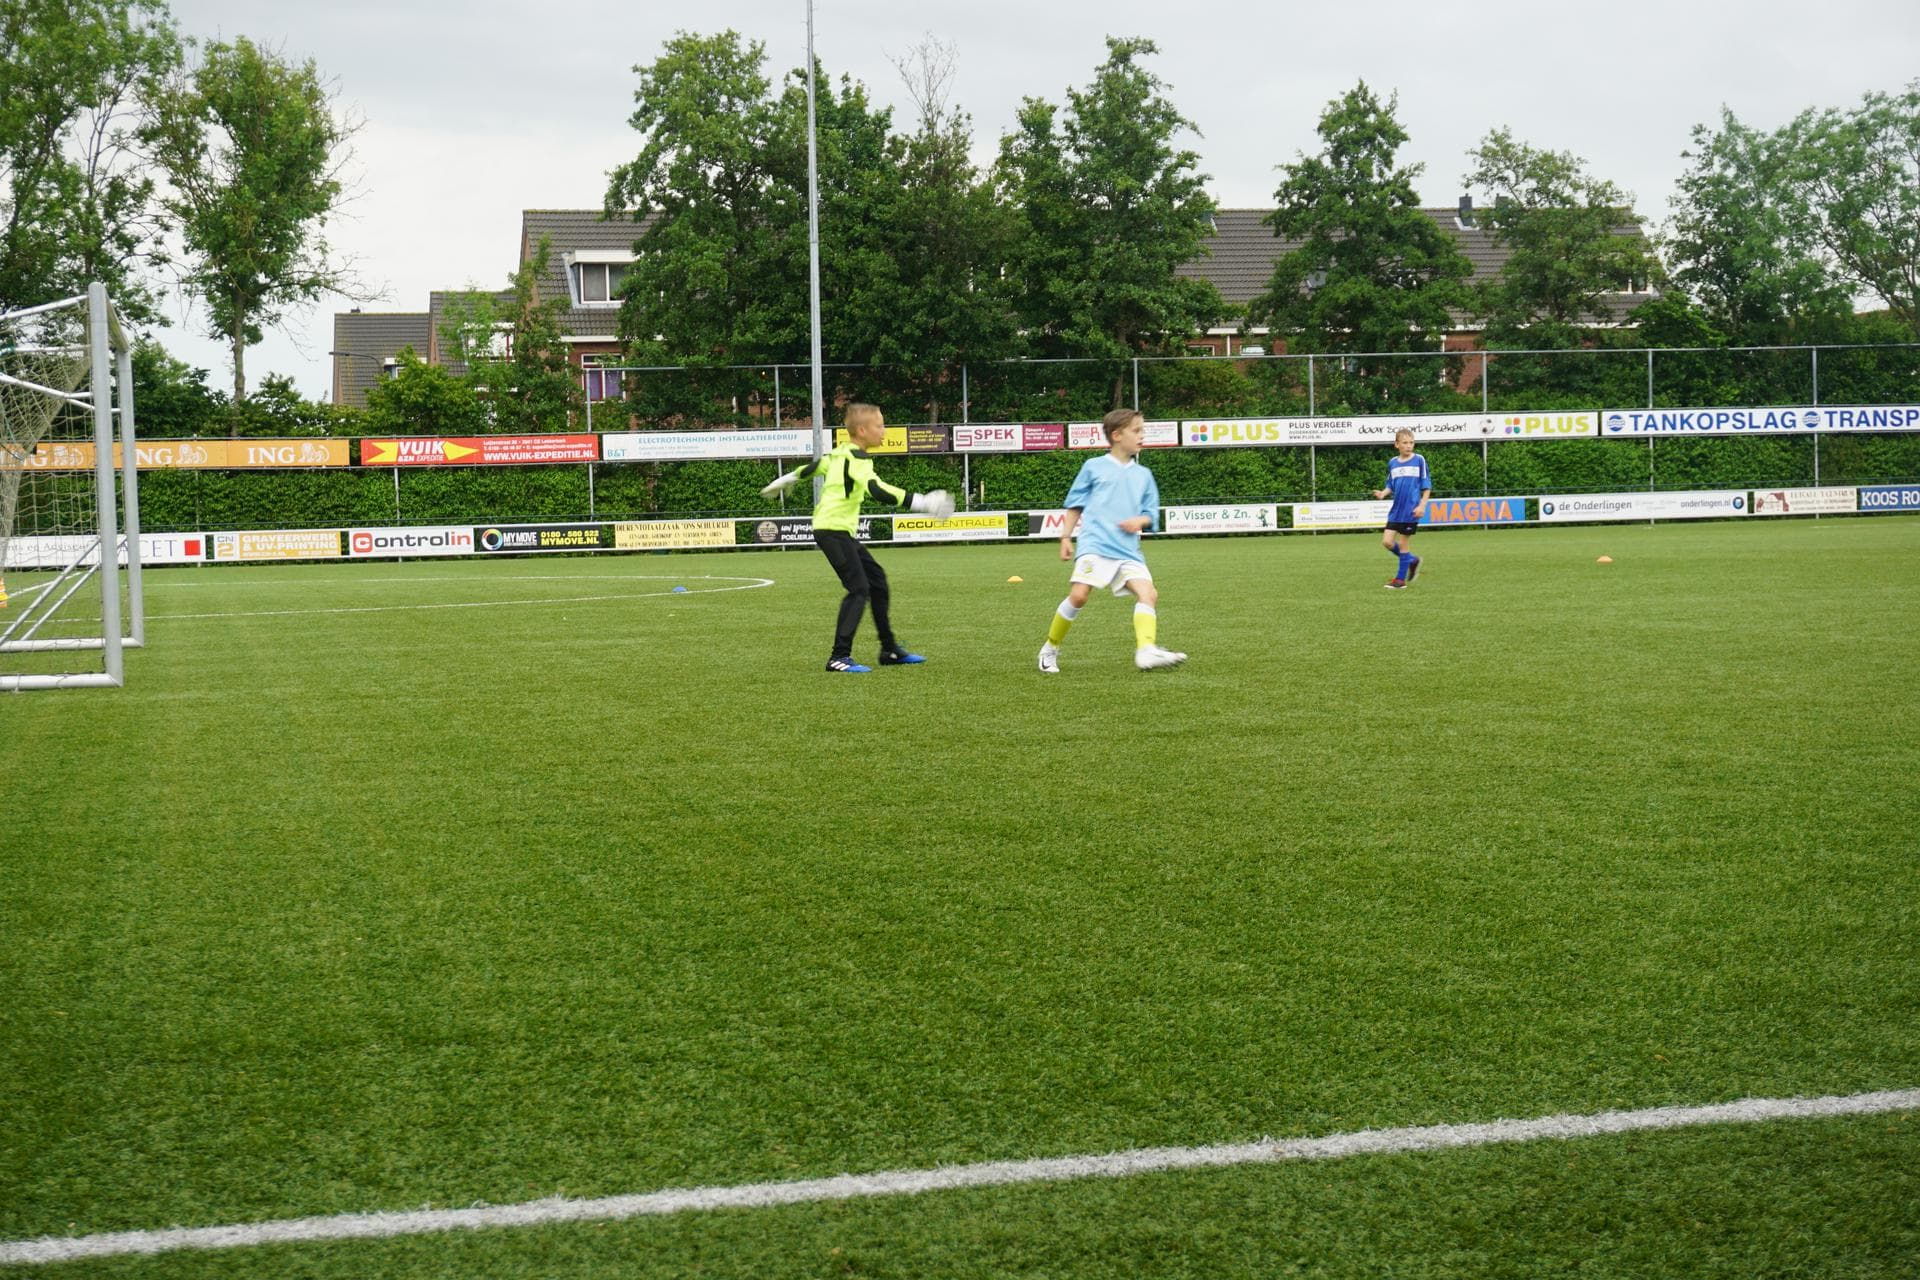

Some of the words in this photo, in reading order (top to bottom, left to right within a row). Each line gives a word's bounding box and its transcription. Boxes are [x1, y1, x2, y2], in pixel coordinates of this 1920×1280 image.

[1525, 415, 1589, 433] PLUS
[1629, 411, 1797, 431] TANKOPSLAG
[1824, 409, 1920, 428] TRANSP
[974, 428, 1015, 440] SPEK
[1213, 422, 1280, 441] PLUS
[1358, 424, 1384, 434] daar
[1425, 425, 1432, 433] u
[1434, 422, 1467, 433] zeker!
[638, 435, 715, 444] ELECTROTECHNISCH
[720, 433, 798, 441] INSTALLATIEBEDRIJF
[399, 440, 445, 455] VUIK
[607, 448, 626, 457] B&T
[134, 448, 173, 466] NG
[247, 447, 295, 464] ING
[483, 449, 596, 461] WWW.VUIK-EXPEDITIE.NL
[1861, 490, 1899, 506] KOOS
[1430, 500, 1513, 522] MAGNA
[1559, 501, 1571, 511] de
[1573, 499, 1632, 511] Onderlingen
[1169, 511, 1179, 521] P.
[1183, 510, 1217, 520] Visser
[1221, 509, 1230, 519] &
[1233, 509, 1251, 519] Zn.
[897, 518, 997, 529] ACCUCENTRALE
[242, 532, 337, 544] GRAVEERWERK
[353, 531, 471, 553] Controlin
[540, 536, 600, 546] MYMOVE.NL
